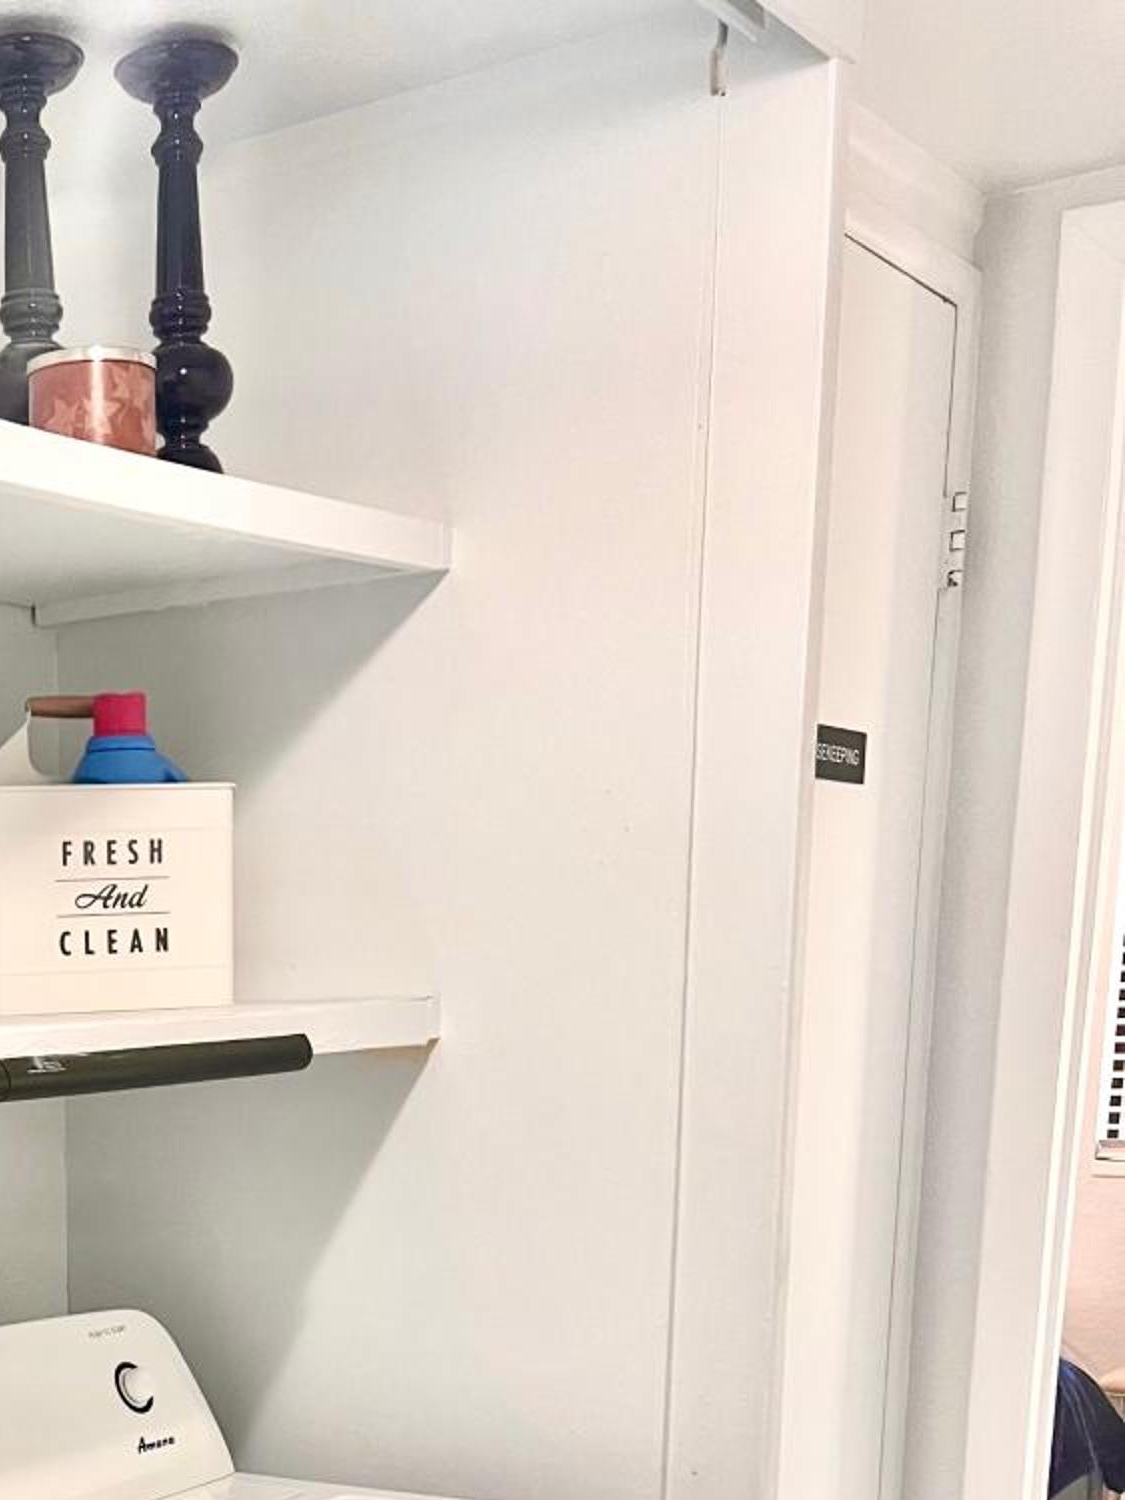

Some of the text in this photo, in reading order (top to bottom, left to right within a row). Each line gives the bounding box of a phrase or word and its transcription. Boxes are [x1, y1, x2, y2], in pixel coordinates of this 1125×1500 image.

[62, 838, 164, 867] FRESH
[74, 883, 150, 909] And
[59, 927, 170, 956] CLEAN
[137, 1436, 176, 1455] Amana
